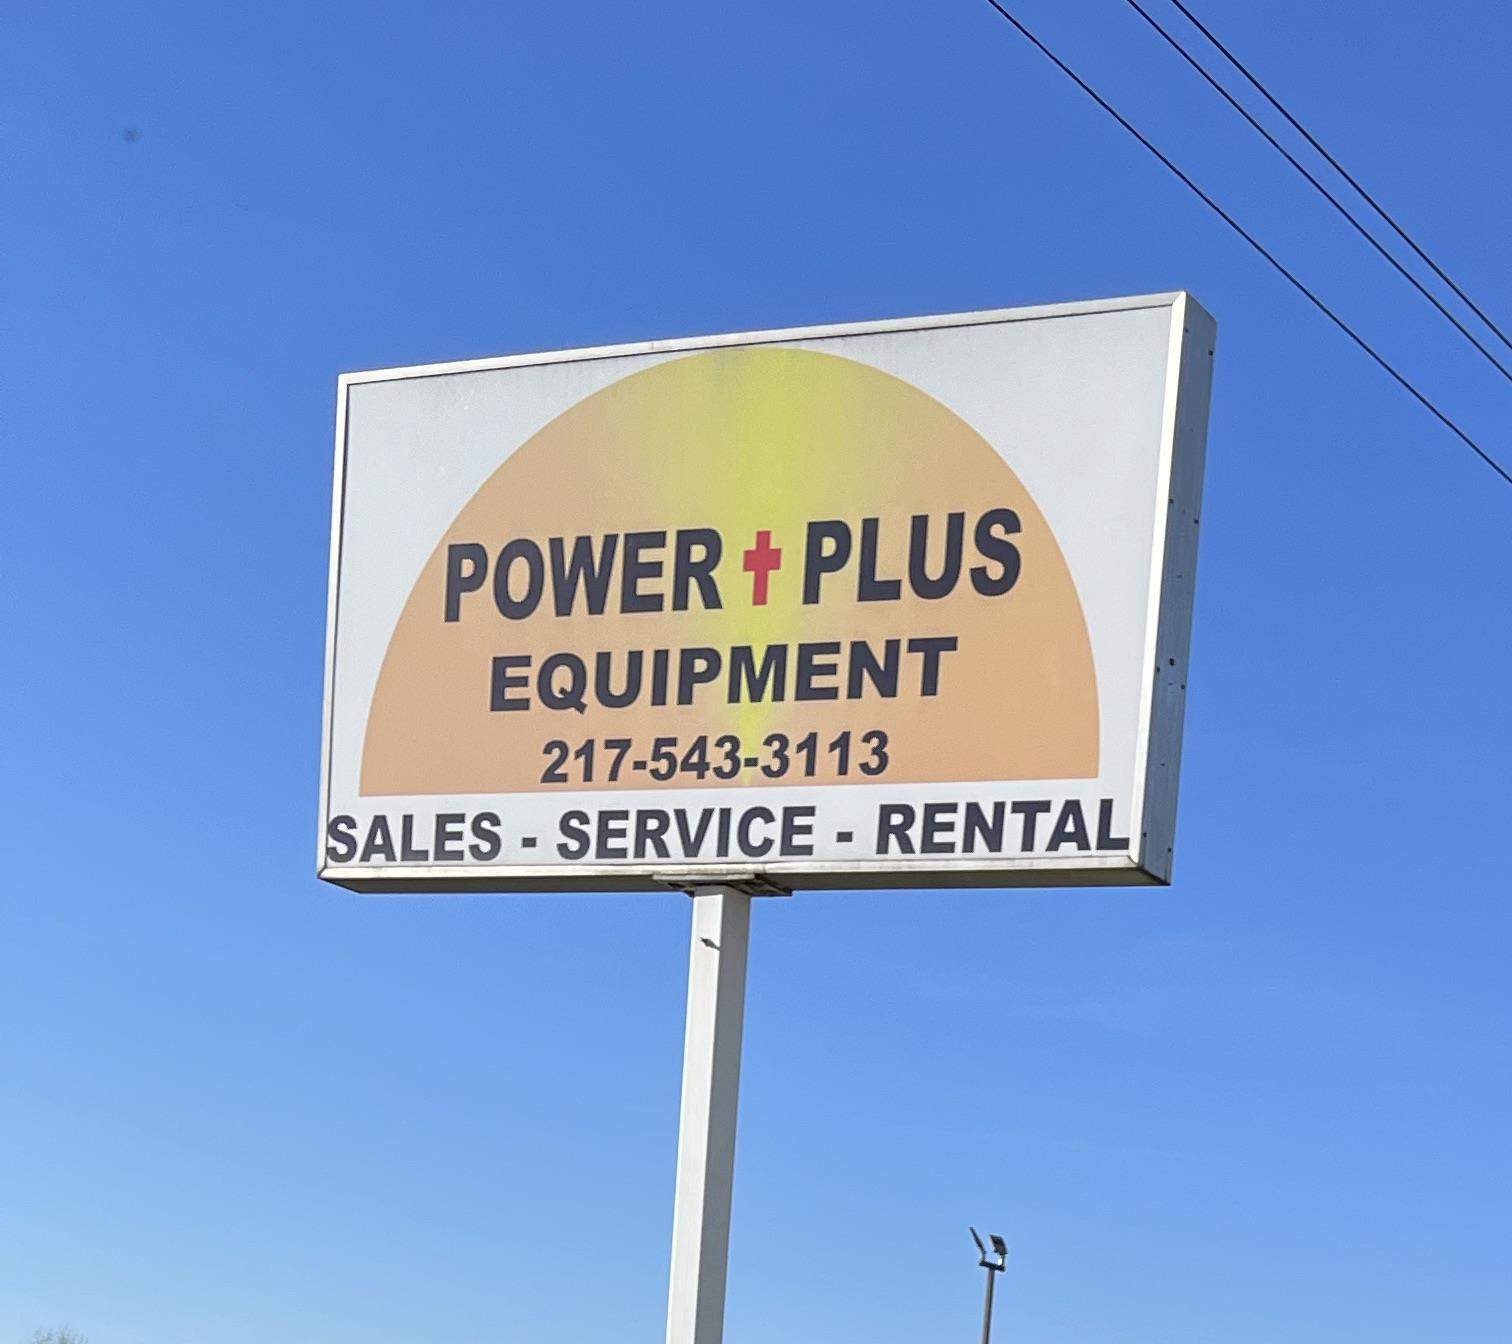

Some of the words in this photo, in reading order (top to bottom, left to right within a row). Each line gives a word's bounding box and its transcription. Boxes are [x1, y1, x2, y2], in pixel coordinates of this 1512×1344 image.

[444, 527, 725, 623] POWER
[802, 507, 1023, 606] PLUS
[490, 636, 959, 715] EQUIPMENT
[541, 729, 890, 784] 217-543-3113
[326, 811, 503, 864] SALES
[556, 805, 816, 861] SERVICE
[877, 799, 1130, 855] RENTAL
